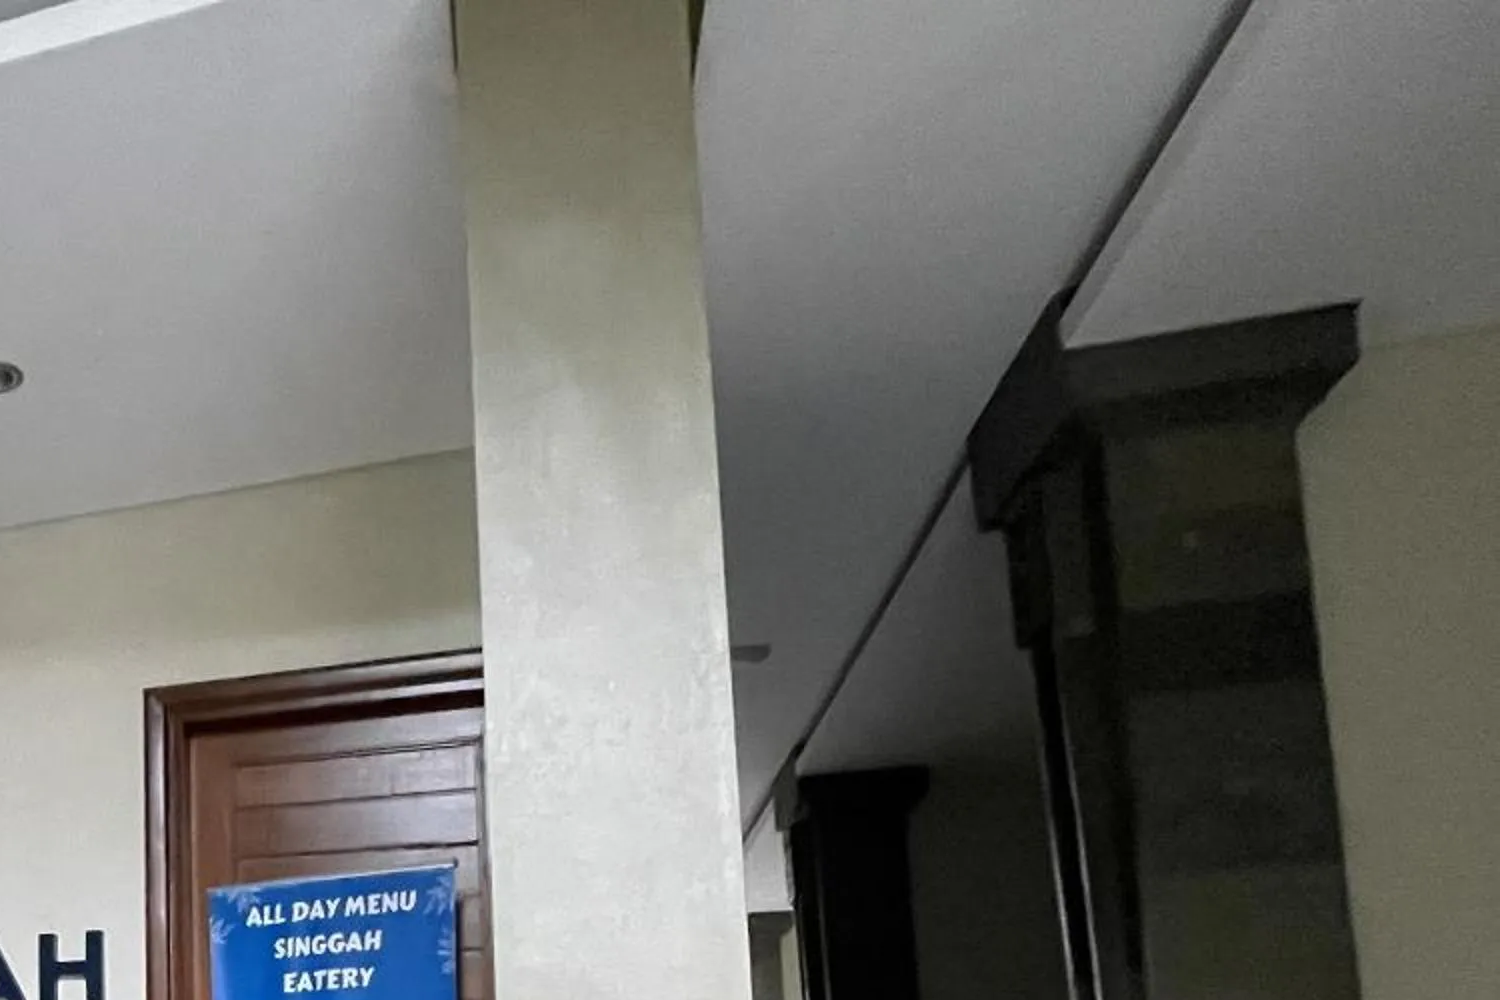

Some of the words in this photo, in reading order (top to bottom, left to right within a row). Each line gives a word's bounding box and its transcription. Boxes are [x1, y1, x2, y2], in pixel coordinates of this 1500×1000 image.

[245, 904, 285, 928] ALL
[291, 897, 341, 923] DAY
[344, 889, 417, 917] MENU
[273, 929, 383, 960] SINGGAH
[282, 966, 375, 994] EATERY
